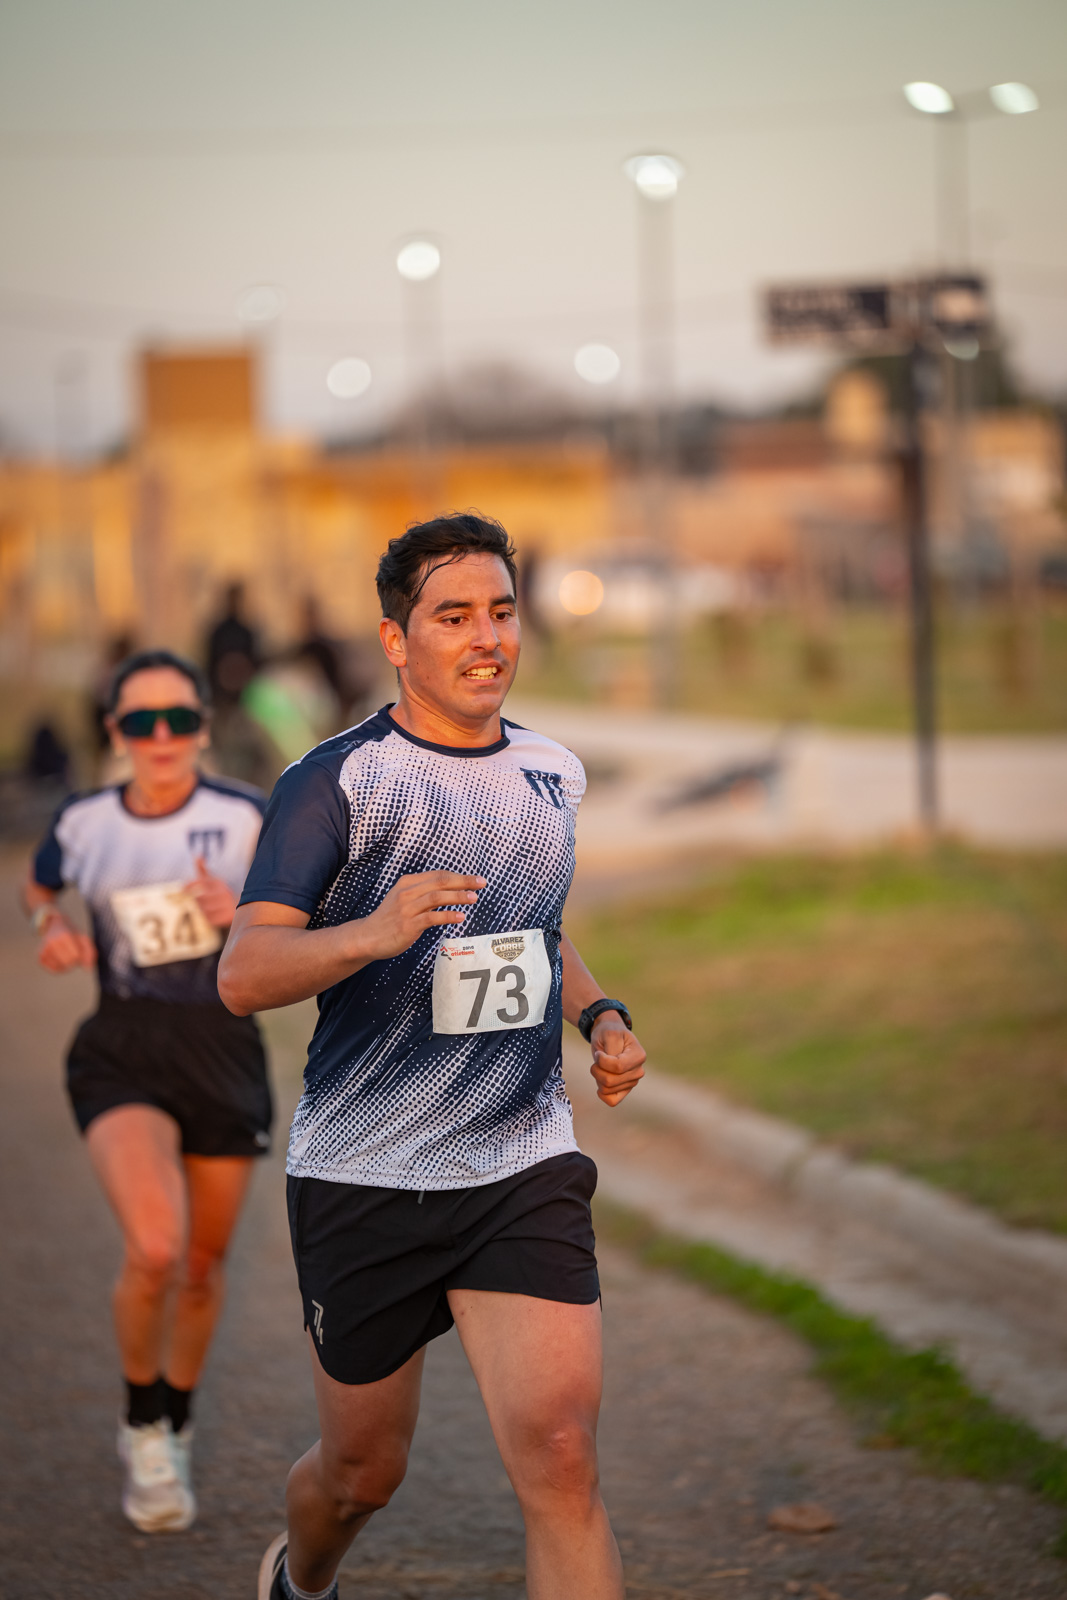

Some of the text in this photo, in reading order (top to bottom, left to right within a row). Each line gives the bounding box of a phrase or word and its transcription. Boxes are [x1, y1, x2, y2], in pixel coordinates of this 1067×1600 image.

[531, 771, 555, 783] SFC
[138, 906, 199, 955] 34
[491, 936, 524, 947] ALVAREZ
[494, 943, 524, 953] CORRE
[460, 965, 529, 1028] 73
